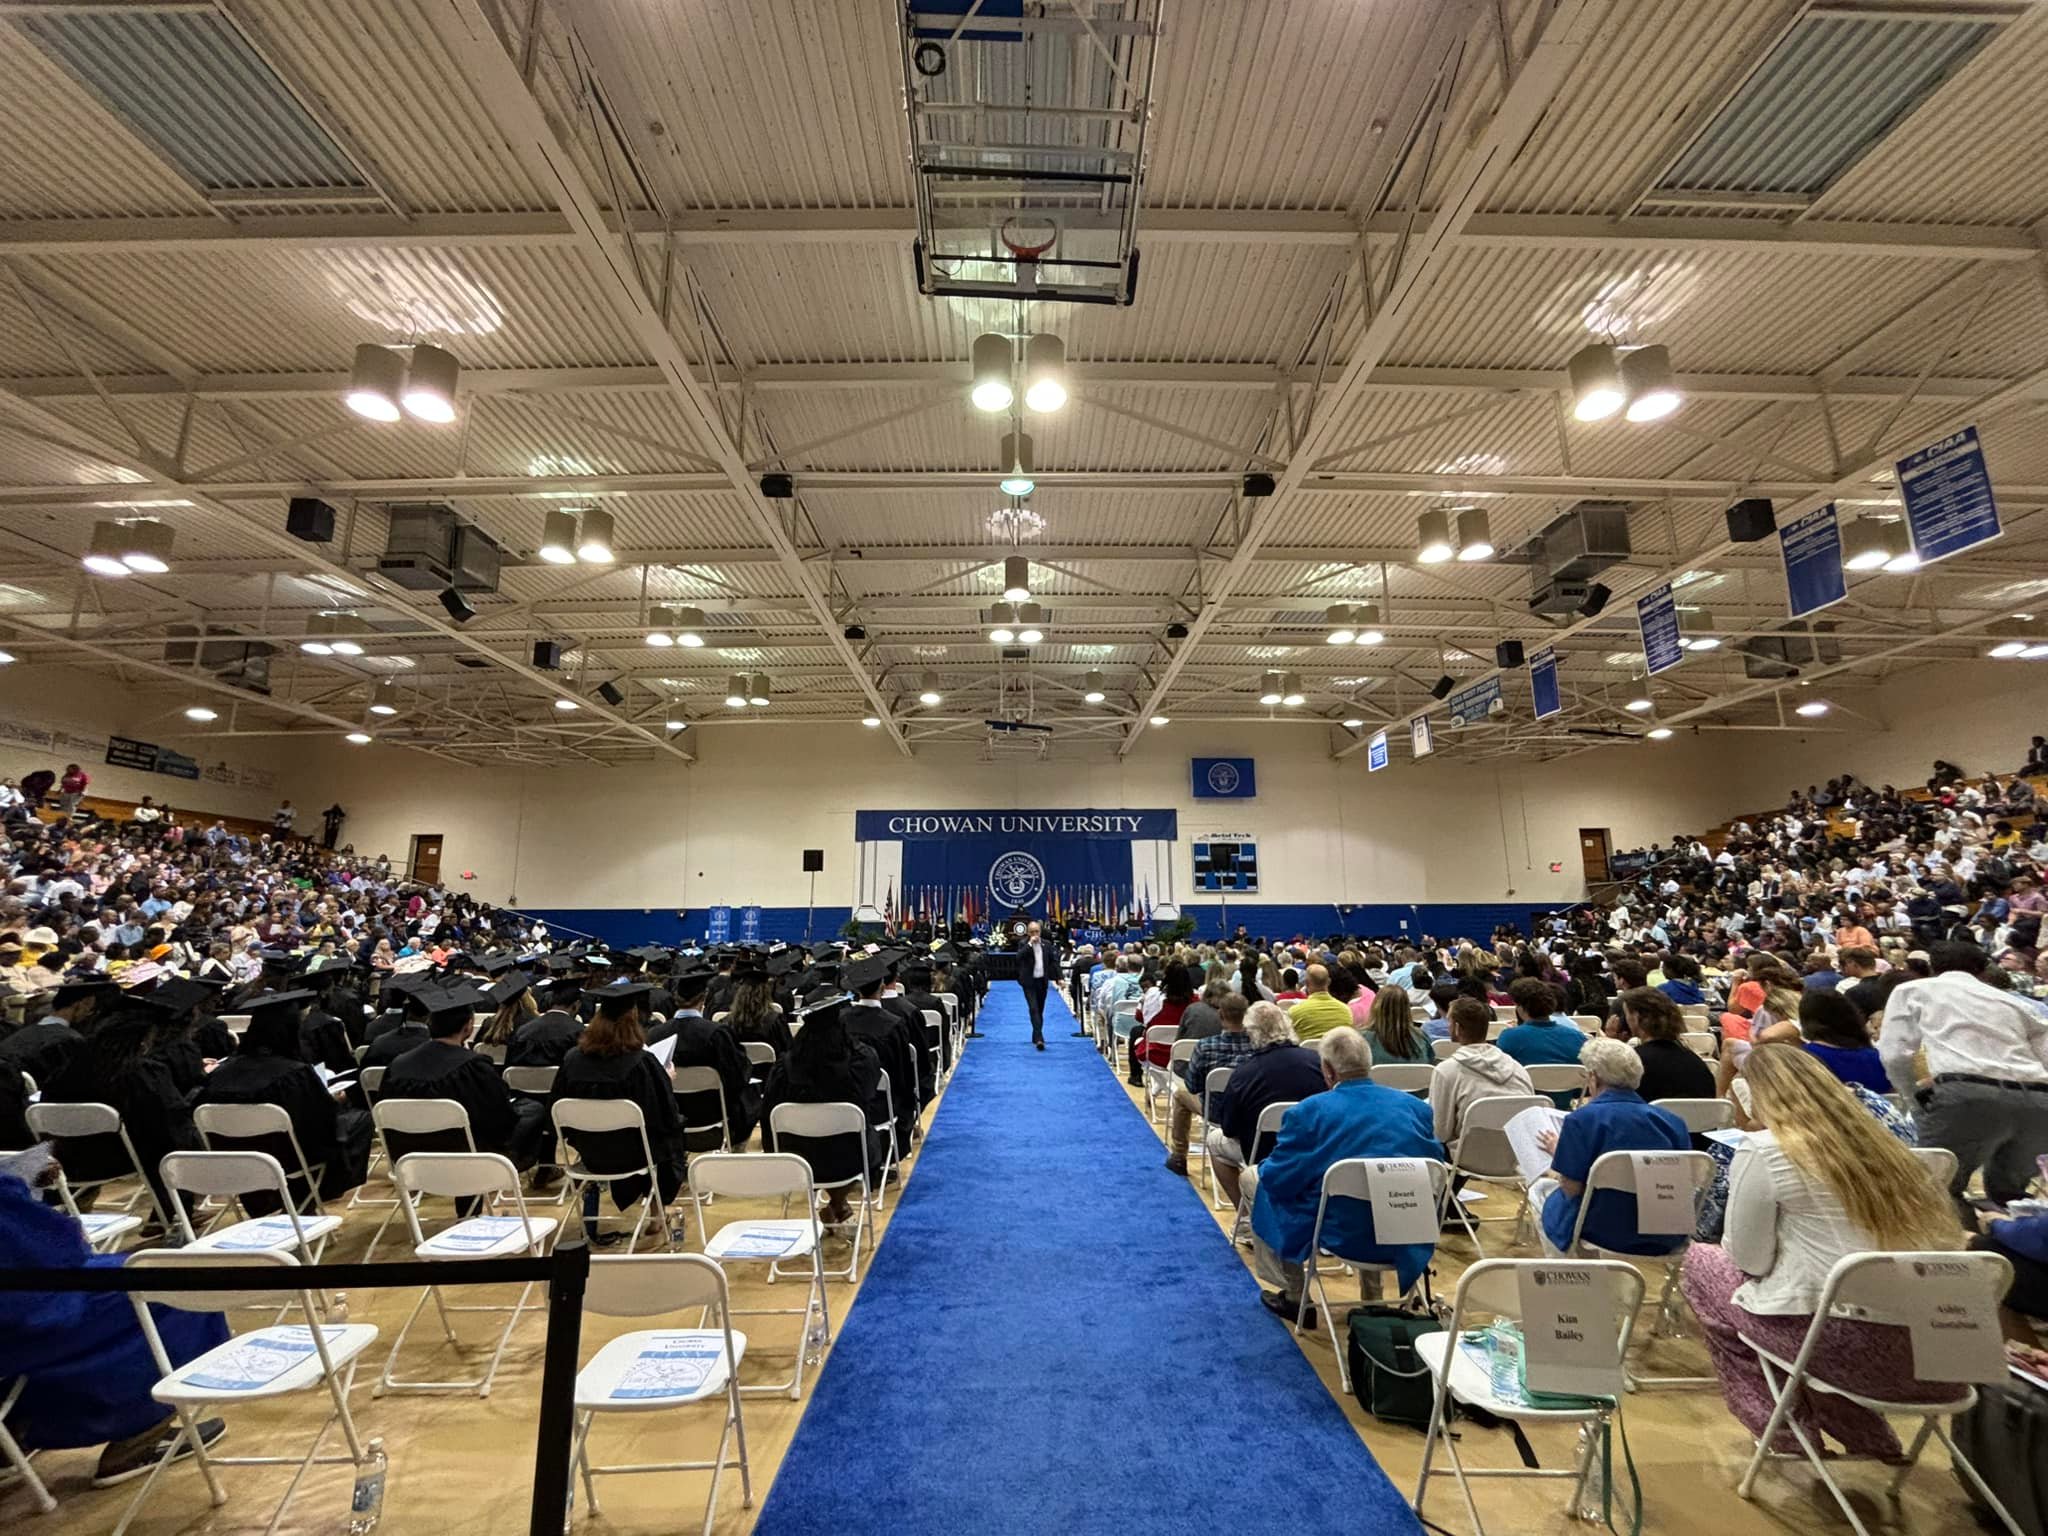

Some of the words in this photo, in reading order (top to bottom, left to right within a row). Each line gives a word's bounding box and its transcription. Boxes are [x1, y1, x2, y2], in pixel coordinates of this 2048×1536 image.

[1926, 432, 1967, 458] CIAA
[888, 817, 993, 833] CHOWAN
[1000, 816, 1143, 833] UNIVERSITY
[1546, 1271, 1591, 1281] CHOWAN
[1557, 1314, 1578, 1324] Kim
[1555, 1329, 1584, 1342] Bailey
